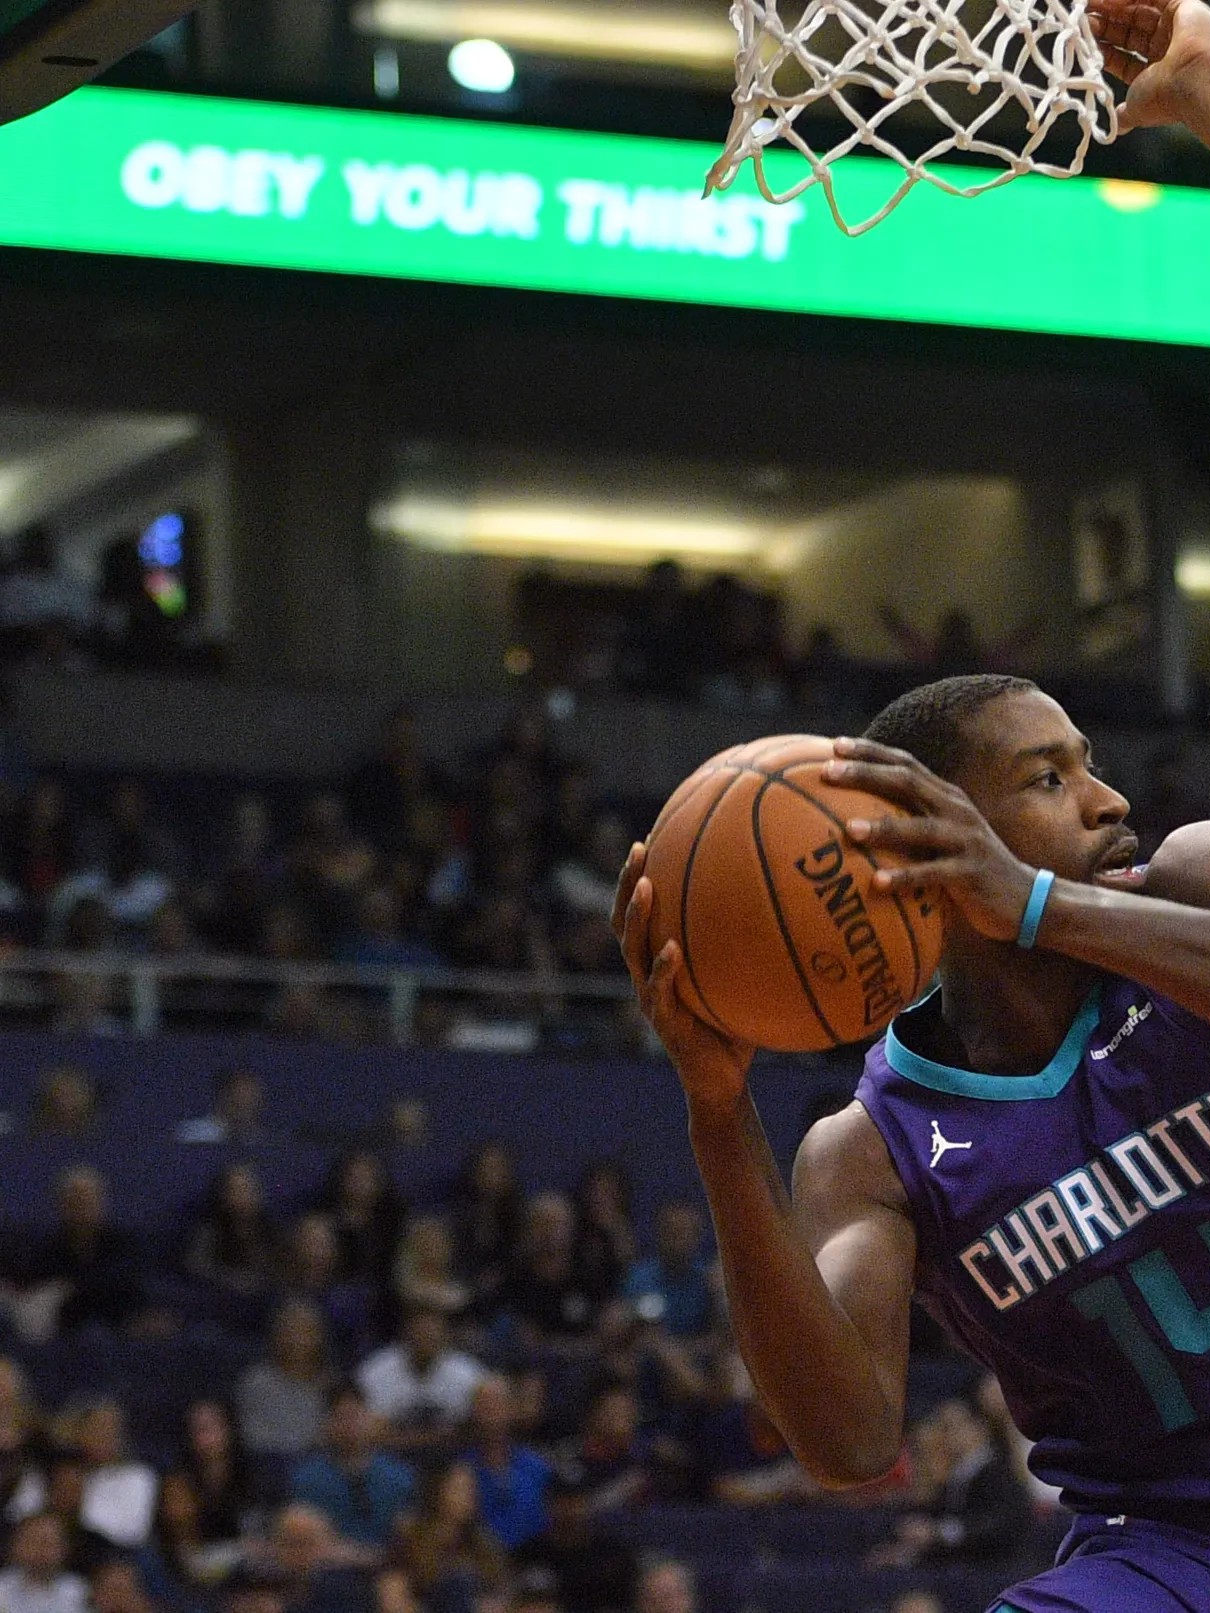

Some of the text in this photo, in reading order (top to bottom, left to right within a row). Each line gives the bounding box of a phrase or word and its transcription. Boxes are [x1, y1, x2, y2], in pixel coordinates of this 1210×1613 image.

[121, 141, 806, 261] OBEY YOUR THIRST
